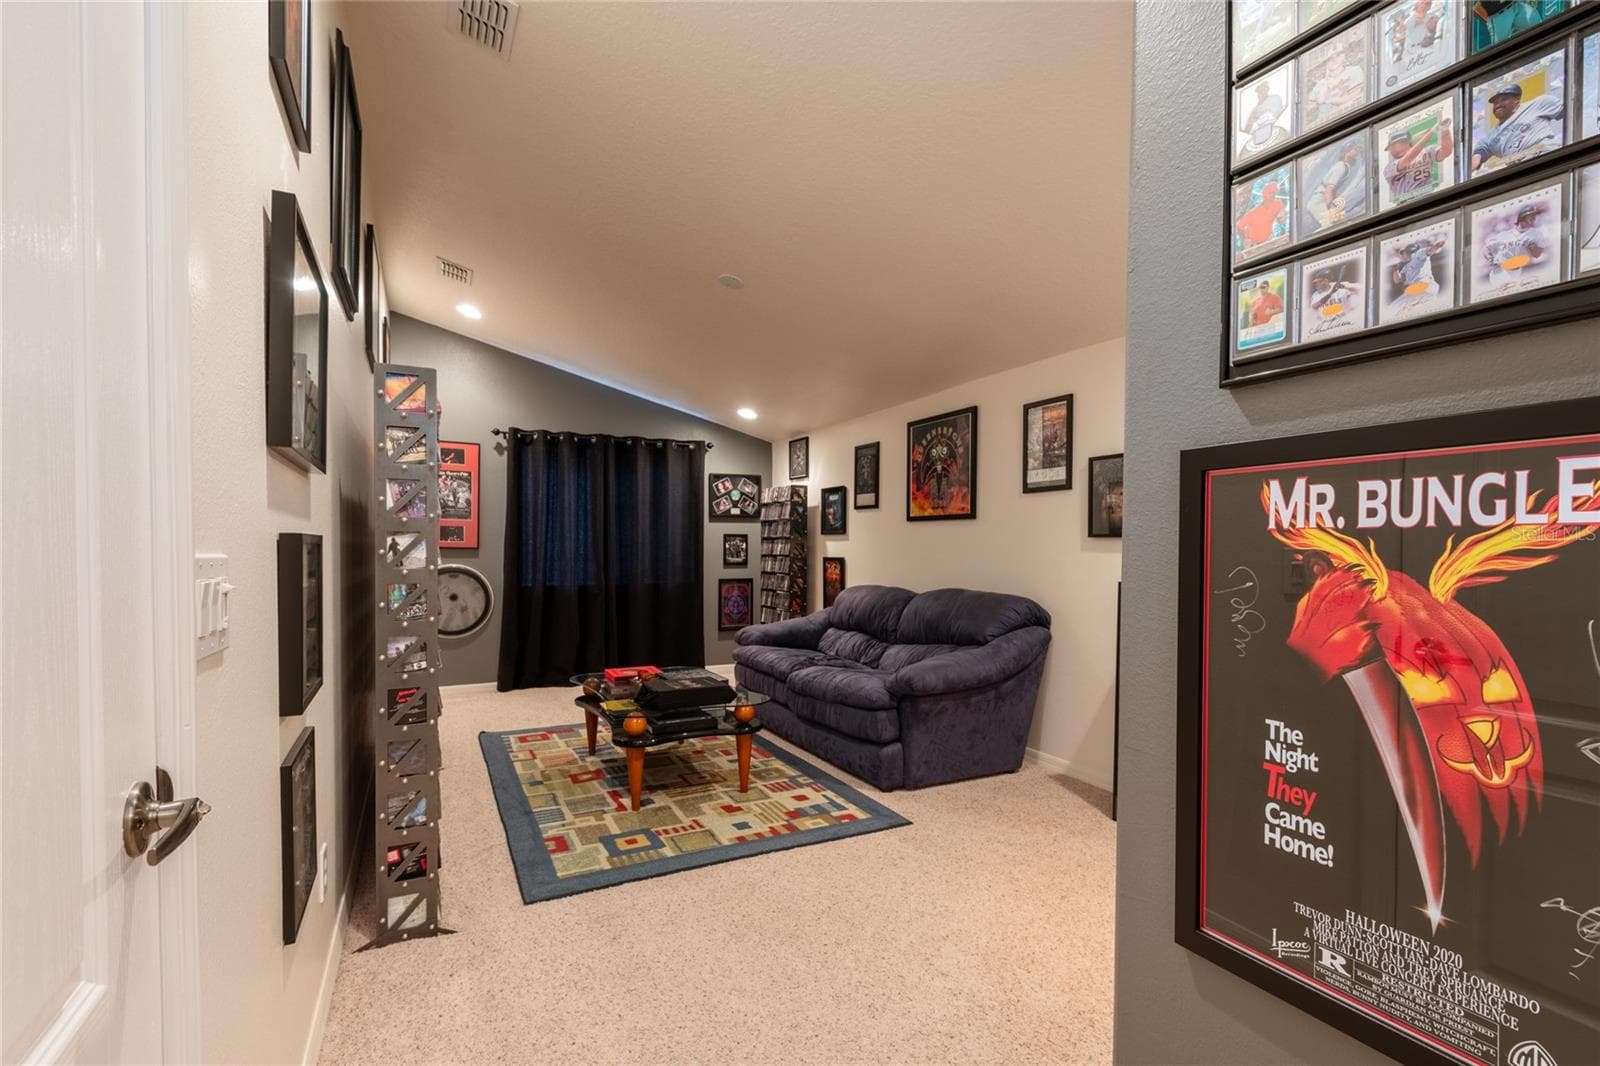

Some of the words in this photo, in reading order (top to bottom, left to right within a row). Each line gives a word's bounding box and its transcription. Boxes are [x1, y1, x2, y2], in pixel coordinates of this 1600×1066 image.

[1413, 169, 1431, 181] 25
[1267, 476, 1345, 530] MR.
[1357, 455, 1600, 528] BUNGLE
[1264, 718, 1304, 746] The
[1264, 740, 1319, 773] Night
[1263, 761, 1317, 816] They
[1264, 802, 1326, 840] Came
[1263, 823, 1334, 868] Home!
[1293, 901, 1331, 929] TREVOR
[1463, 971, 1541, 1014] LOMBARDO
[1345, 909, 1430, 956] HALLOWEEN
[1433, 945, 1463, 969] 2020
[1304, 927, 1310, 938] A
[1312, 929, 1354, 957] VIRTUAL
[1355, 948, 1379, 968] LIVE
[1381, 960, 1433, 992] CONCERT
[1438, 985, 1519, 1031] EXPERIENCE
[1313, 920, 1337, 941] MIKE
[1340, 931, 1379, 958] PATTON
[1381, 950, 1405, 968] AND
[1409, 961, 1437, 985] TREY
[1440, 975, 1505, 1012] SPRUANCE
[1318, 946, 1352, 977] R
[1382, 973, 1464, 1016] RESTRICTED
[1414, 1020, 1431, 1032] AND
[1434, 1028, 1482, 1056] VOMITING
[1428, 1003, 1495, 1038] ACCOMPANIED
